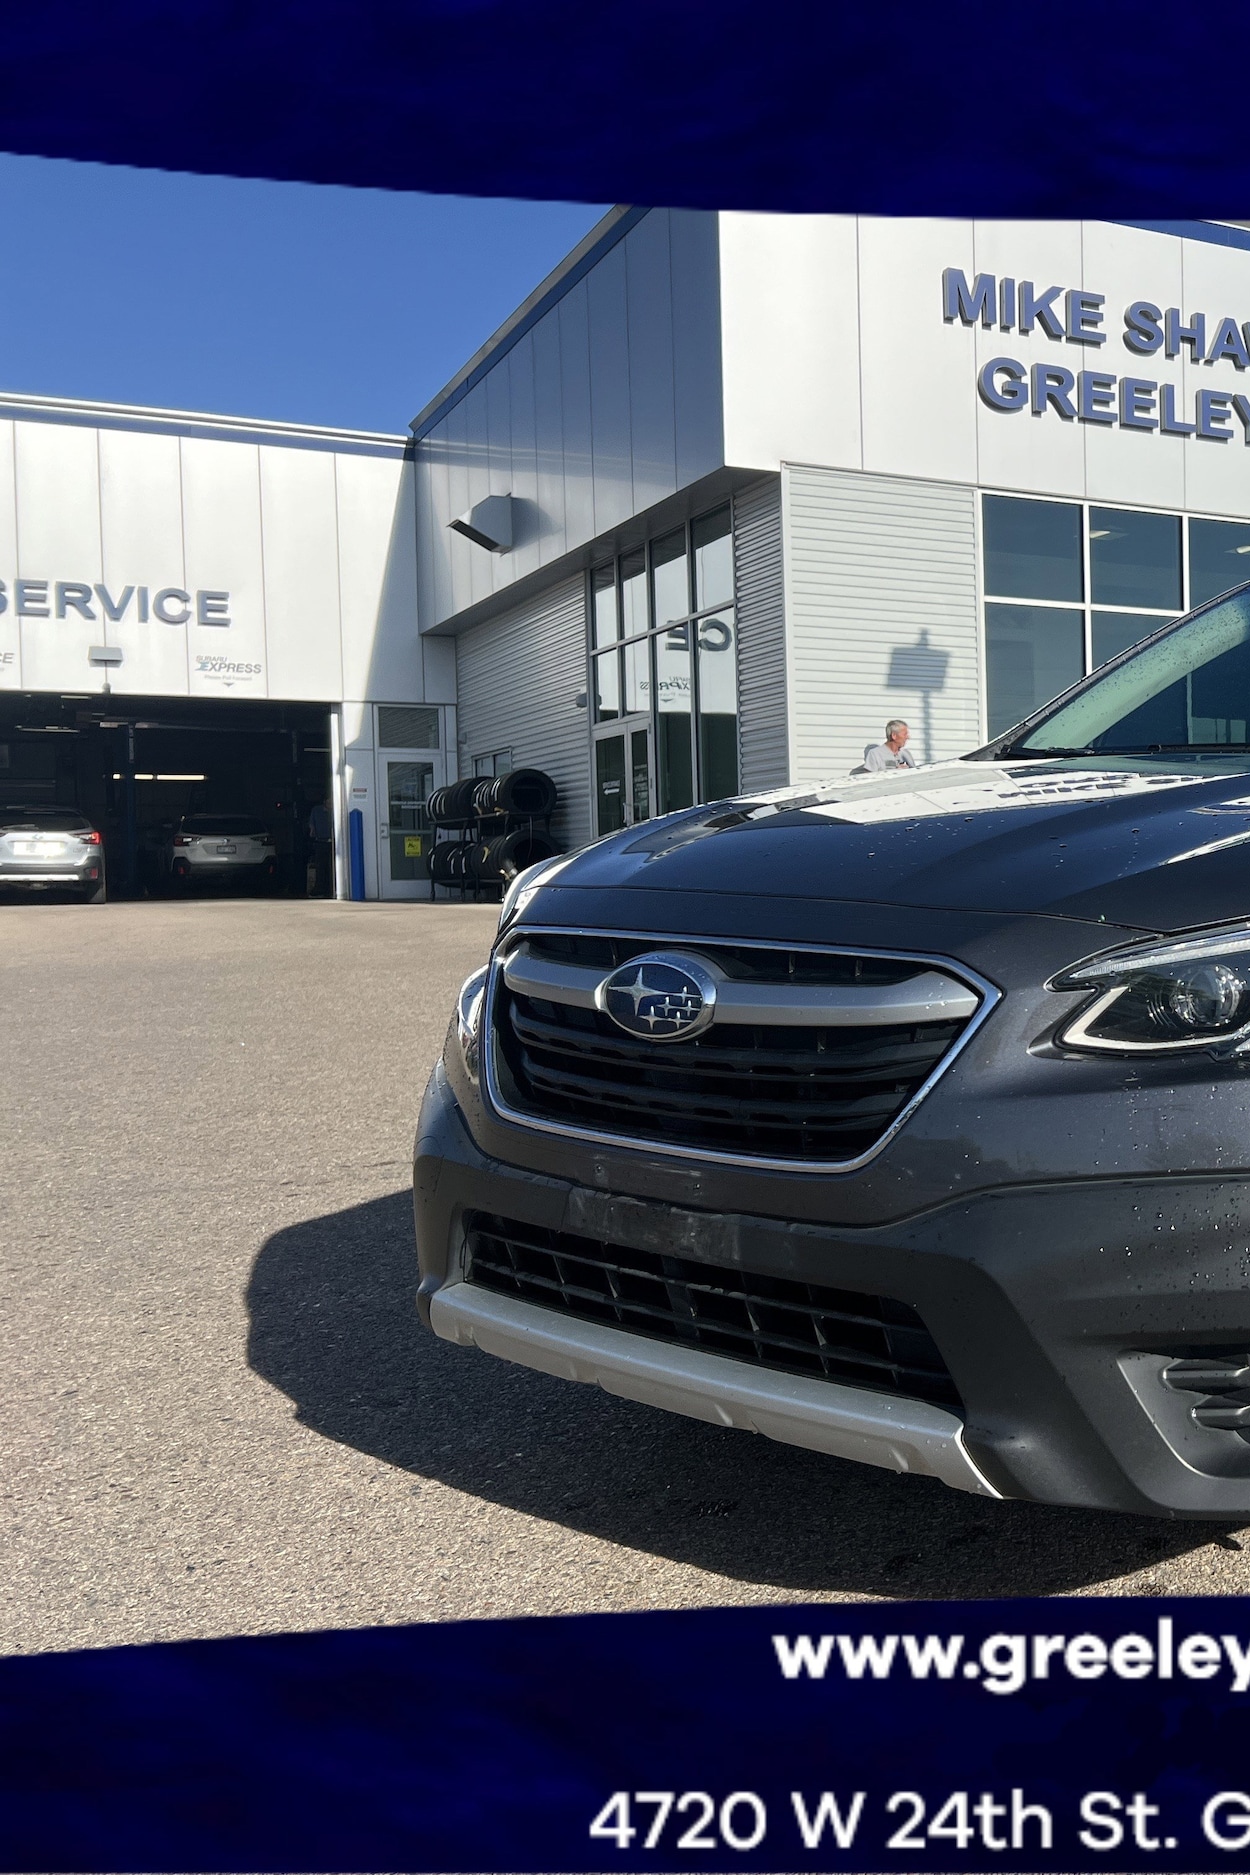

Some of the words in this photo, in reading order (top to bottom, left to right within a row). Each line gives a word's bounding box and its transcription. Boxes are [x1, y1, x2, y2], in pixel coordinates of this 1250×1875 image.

[942, 267, 1107, 349] MIKE
[0, 578, 231, 627] ERVICE
[194, 661, 262, 674] EXPRESS
